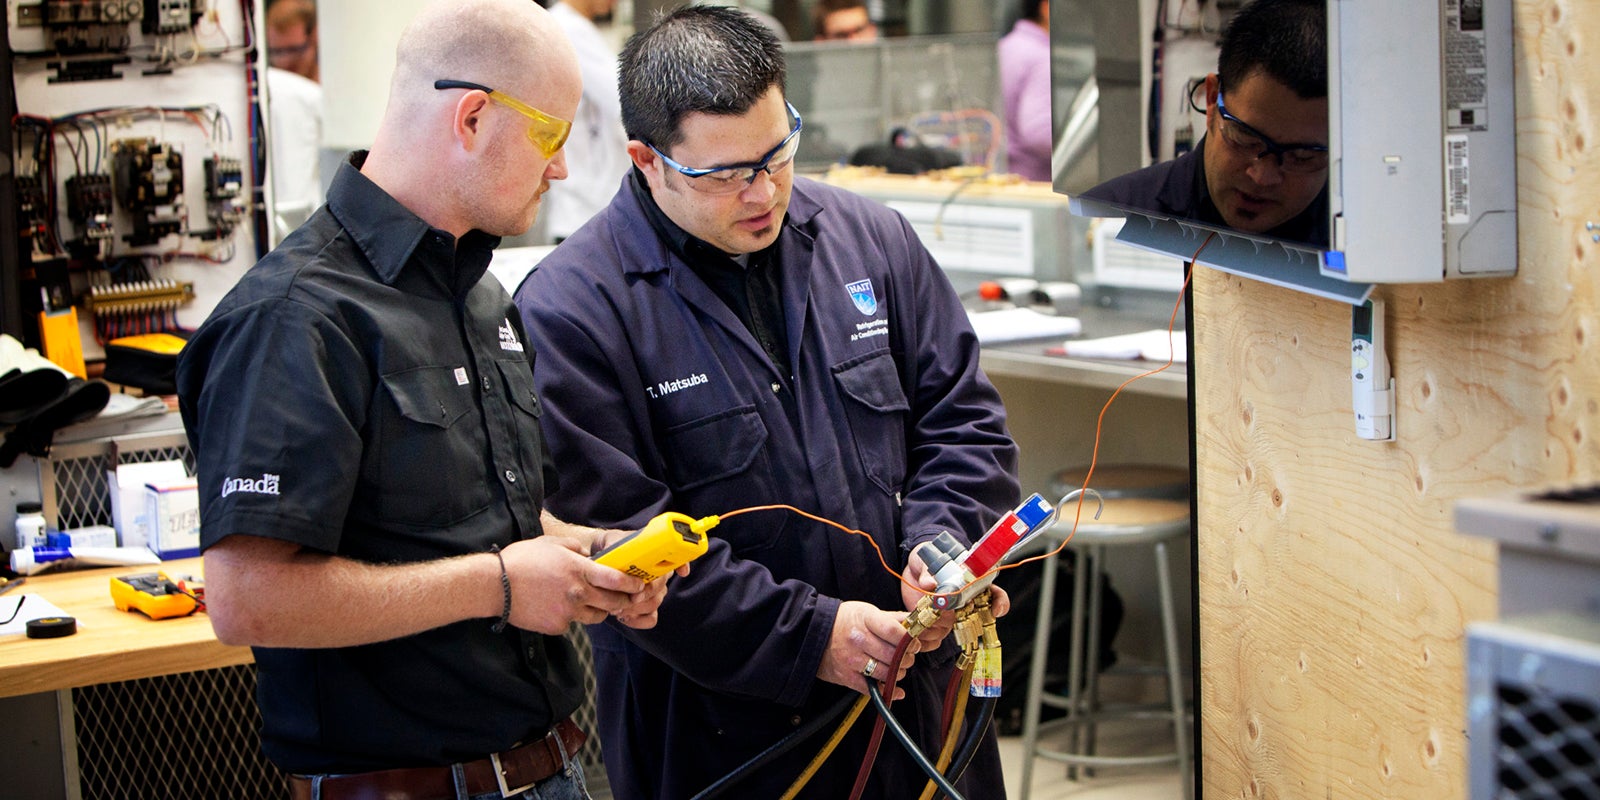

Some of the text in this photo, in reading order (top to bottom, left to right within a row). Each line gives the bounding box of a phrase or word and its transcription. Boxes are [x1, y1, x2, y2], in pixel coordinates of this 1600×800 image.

[849, 282, 870, 294] NAIT
[646, 373, 709, 399] T. Matsuba
[221, 473, 281, 498] Canada
